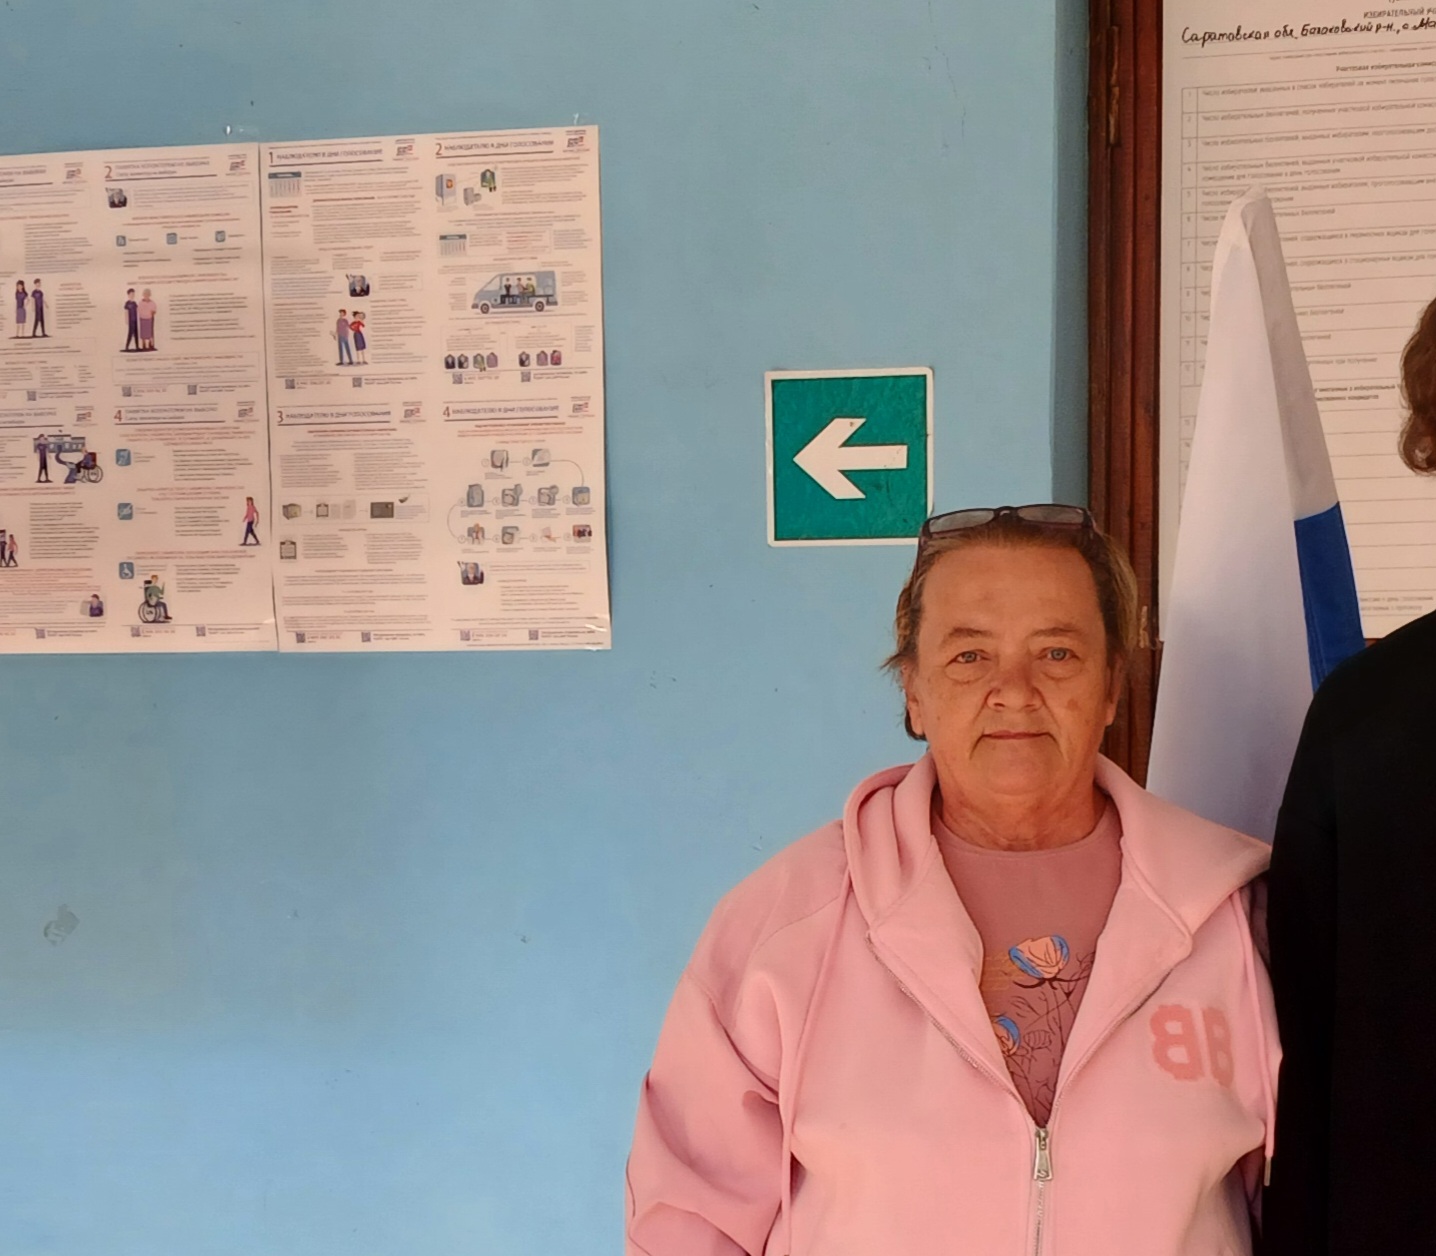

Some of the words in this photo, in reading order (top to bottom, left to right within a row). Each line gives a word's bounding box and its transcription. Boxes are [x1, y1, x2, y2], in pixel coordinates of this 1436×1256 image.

[435, 143, 443, 156] 2
[268, 152, 274, 164] 1
[104, 165, 113, 179] 2
[114, 409, 122, 422] 4
[276, 410, 284, 424] 3
[443, 405, 450, 418] 4
